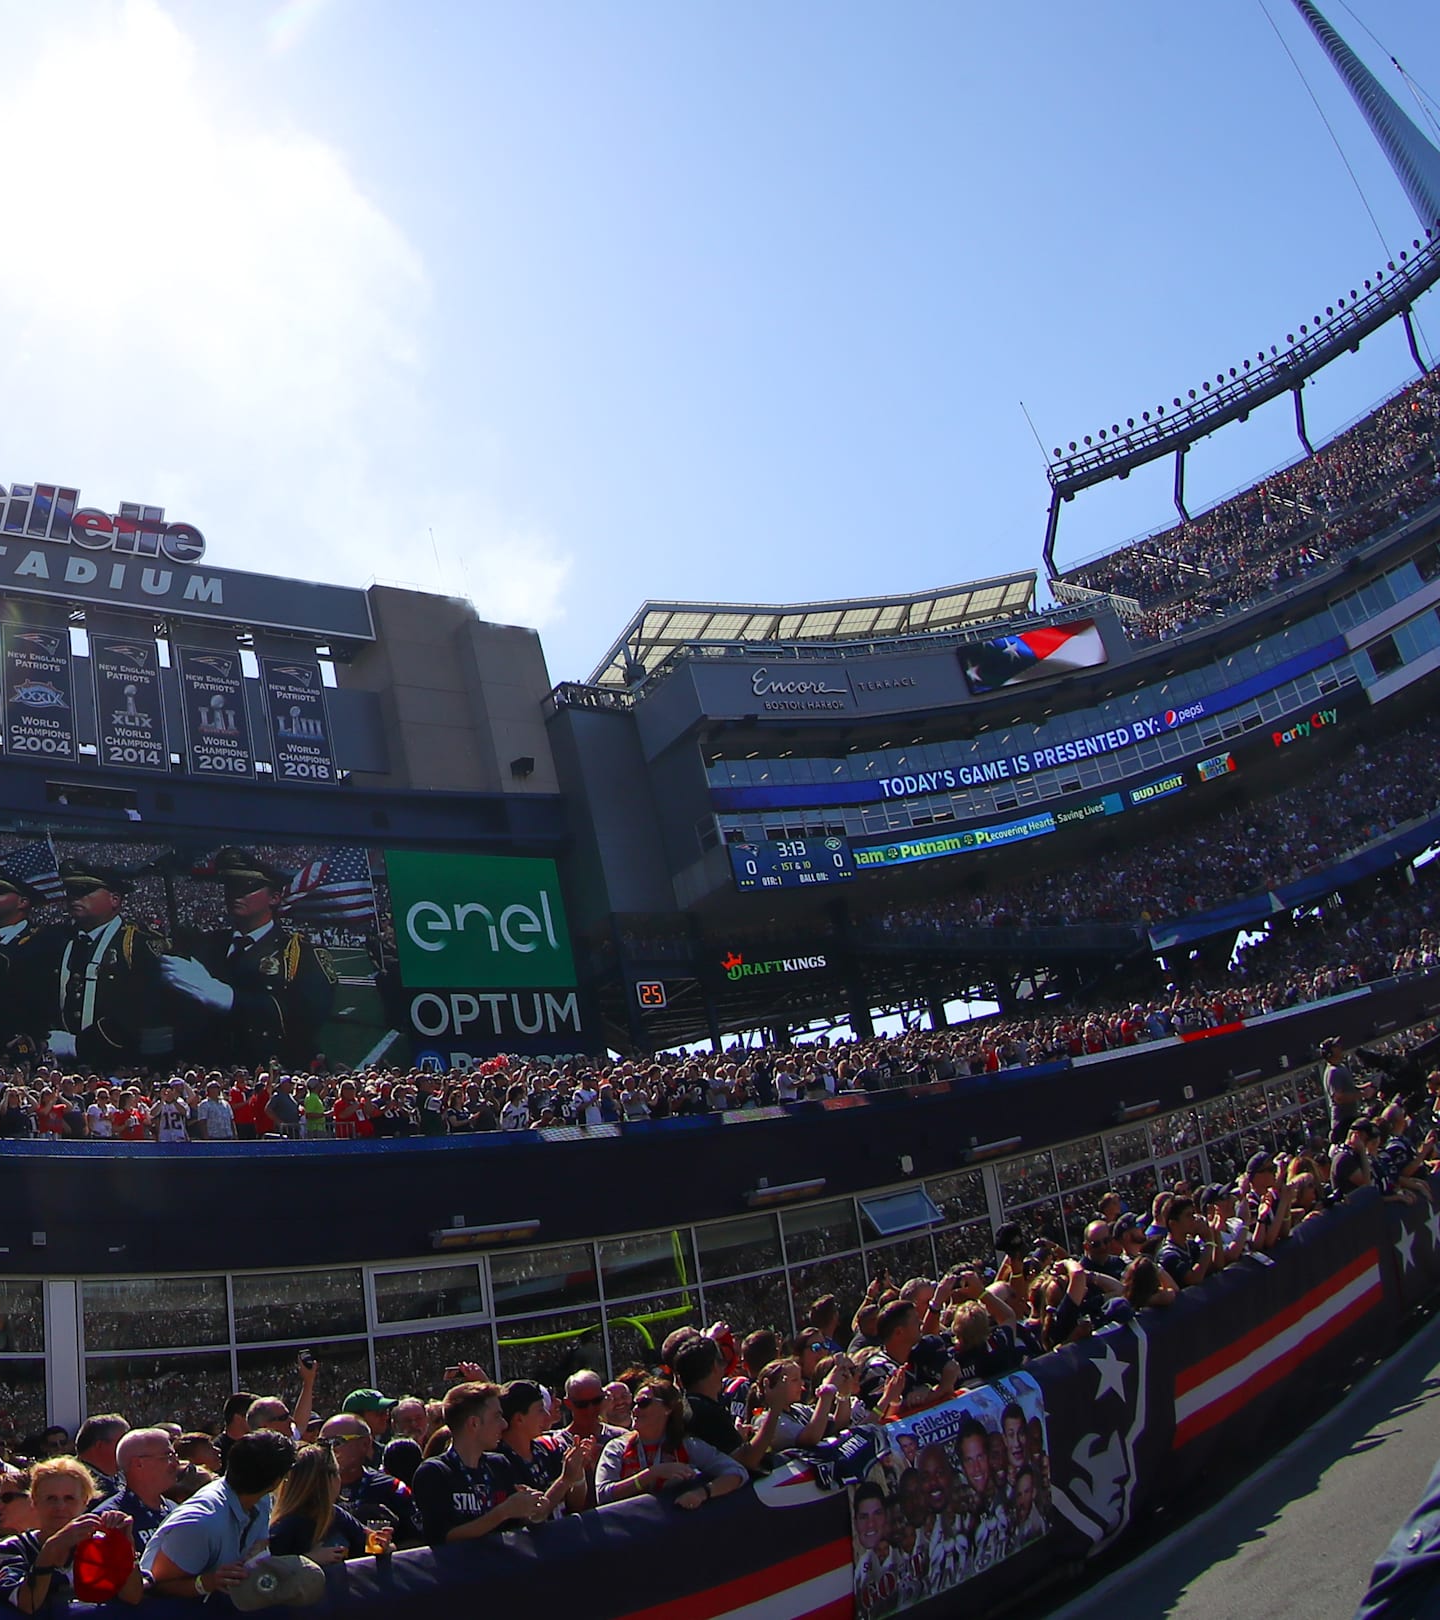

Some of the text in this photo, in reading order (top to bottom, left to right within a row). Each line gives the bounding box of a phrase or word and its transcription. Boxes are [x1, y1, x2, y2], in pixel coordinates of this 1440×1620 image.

[752, 667, 847, 696] Encore
[858, 677, 917, 691] TERRACE
[765, 700, 844, 710] BOSTON HARBOR
[1178, 702, 1204, 723] pepsi
[111, 714, 152, 728] XLIX
[1272, 708, 1337, 747] Party City
[12, 735, 71, 755] 2004
[110, 747, 160, 765] 2014
[199, 755, 247, 772] 2016
[879, 717, 1161, 797] TODAY'S GAME IS PRESENTED BY:
[285, 762, 329, 779] 2018
[1133, 776, 1183, 802] BUD LIGHT
[900, 837, 960, 857] Putnam
[1058, 809, 1084, 823] Saving
[776, 841, 806, 857] 3:13
[746, 860, 757, 874] 0
[782, 862, 793, 870] 1ST
[833, 854, 844, 868] 0
[406, 891, 560, 953] enel
[642, 985, 662, 1004] 25
[410, 993, 582, 1037] OPTUM
[163, 1111, 184, 1130] 12
[912, 1409, 961, 1435] Gillette
[918, 1422, 960, 1447] STADIU
